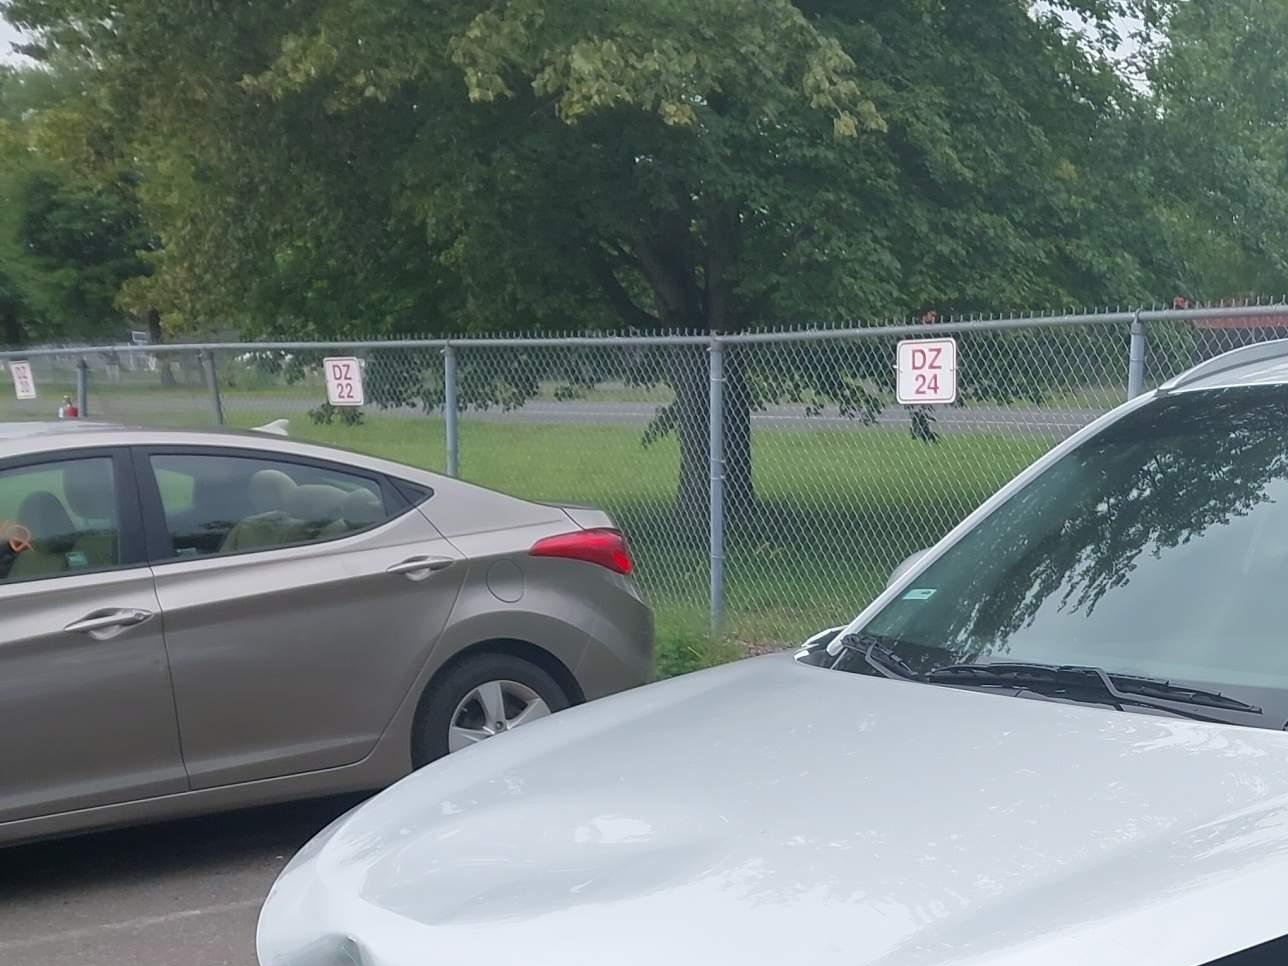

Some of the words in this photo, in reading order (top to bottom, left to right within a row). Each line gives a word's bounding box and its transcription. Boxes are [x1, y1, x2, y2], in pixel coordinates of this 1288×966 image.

[911, 347, 942, 370] DZ
[332, 364, 352, 380] DZ
[336, 383, 354, 399] 22
[914, 373, 940, 395] 24
